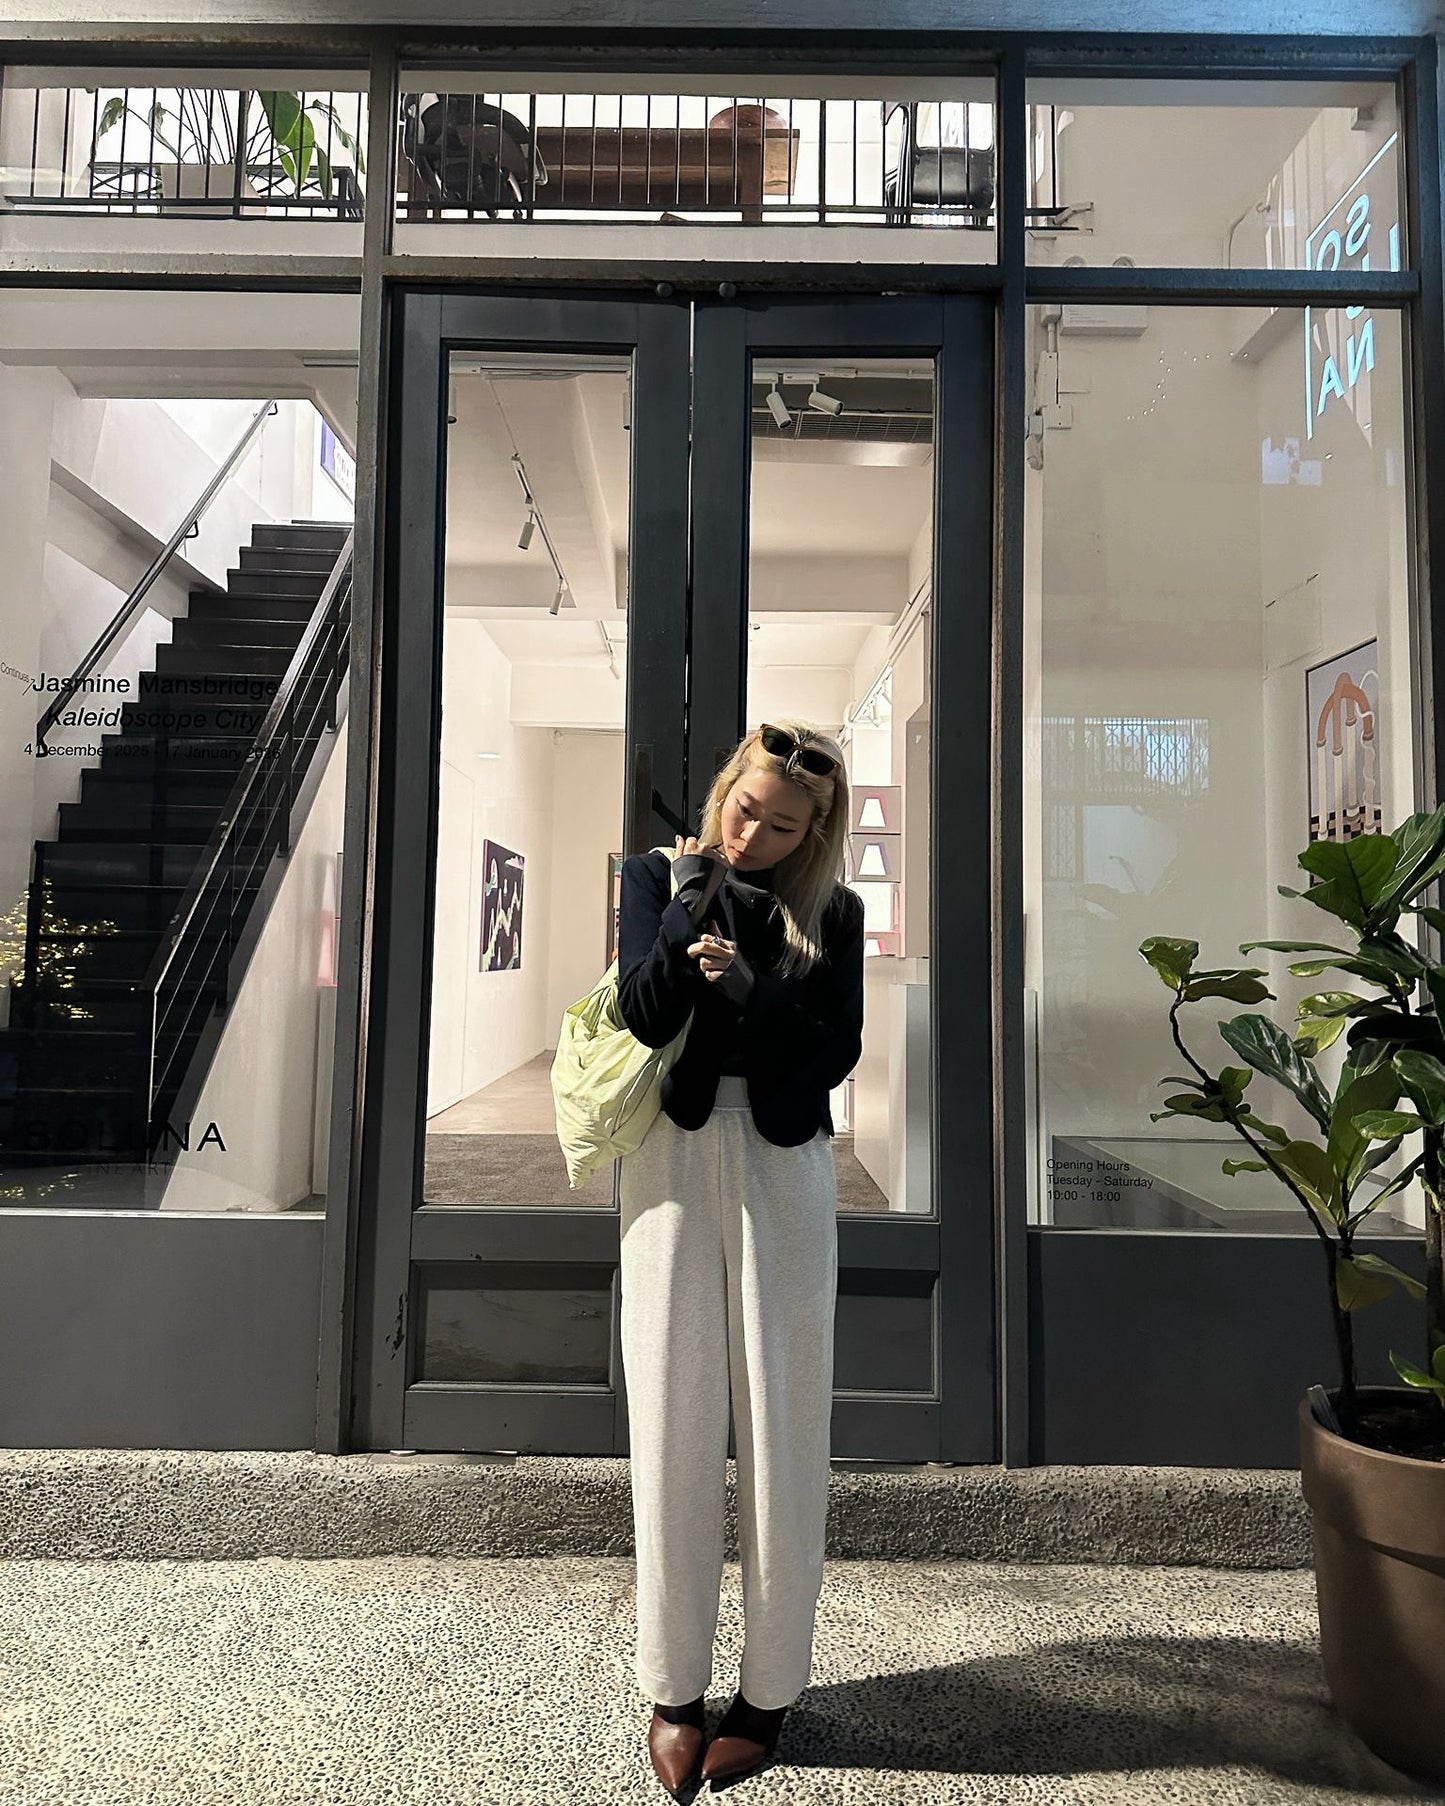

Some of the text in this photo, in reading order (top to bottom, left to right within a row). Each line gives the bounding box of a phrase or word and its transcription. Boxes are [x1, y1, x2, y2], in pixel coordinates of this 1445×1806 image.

[33, 672, 278, 700] Jasmine Mansbridge
[47, 707, 262, 734] Kaleidoscope City
[24, 743, 32, 755] 4
[37, 744, 107, 757] December
[184, 746, 241, 762] January
[247, 747, 281, 759] 2026
[24, 1120, 227, 1152] SOLUNA
[1046, 1158, 1130, 1172] Opening Hours
[1047, 1174, 1092, 1188] Tuesday
[1104, 1175, 1154, 1189] Saturday
[1048, 1190, 1078, 1200] 10:00
[1090, 1191, 1121, 1202] 18:00
